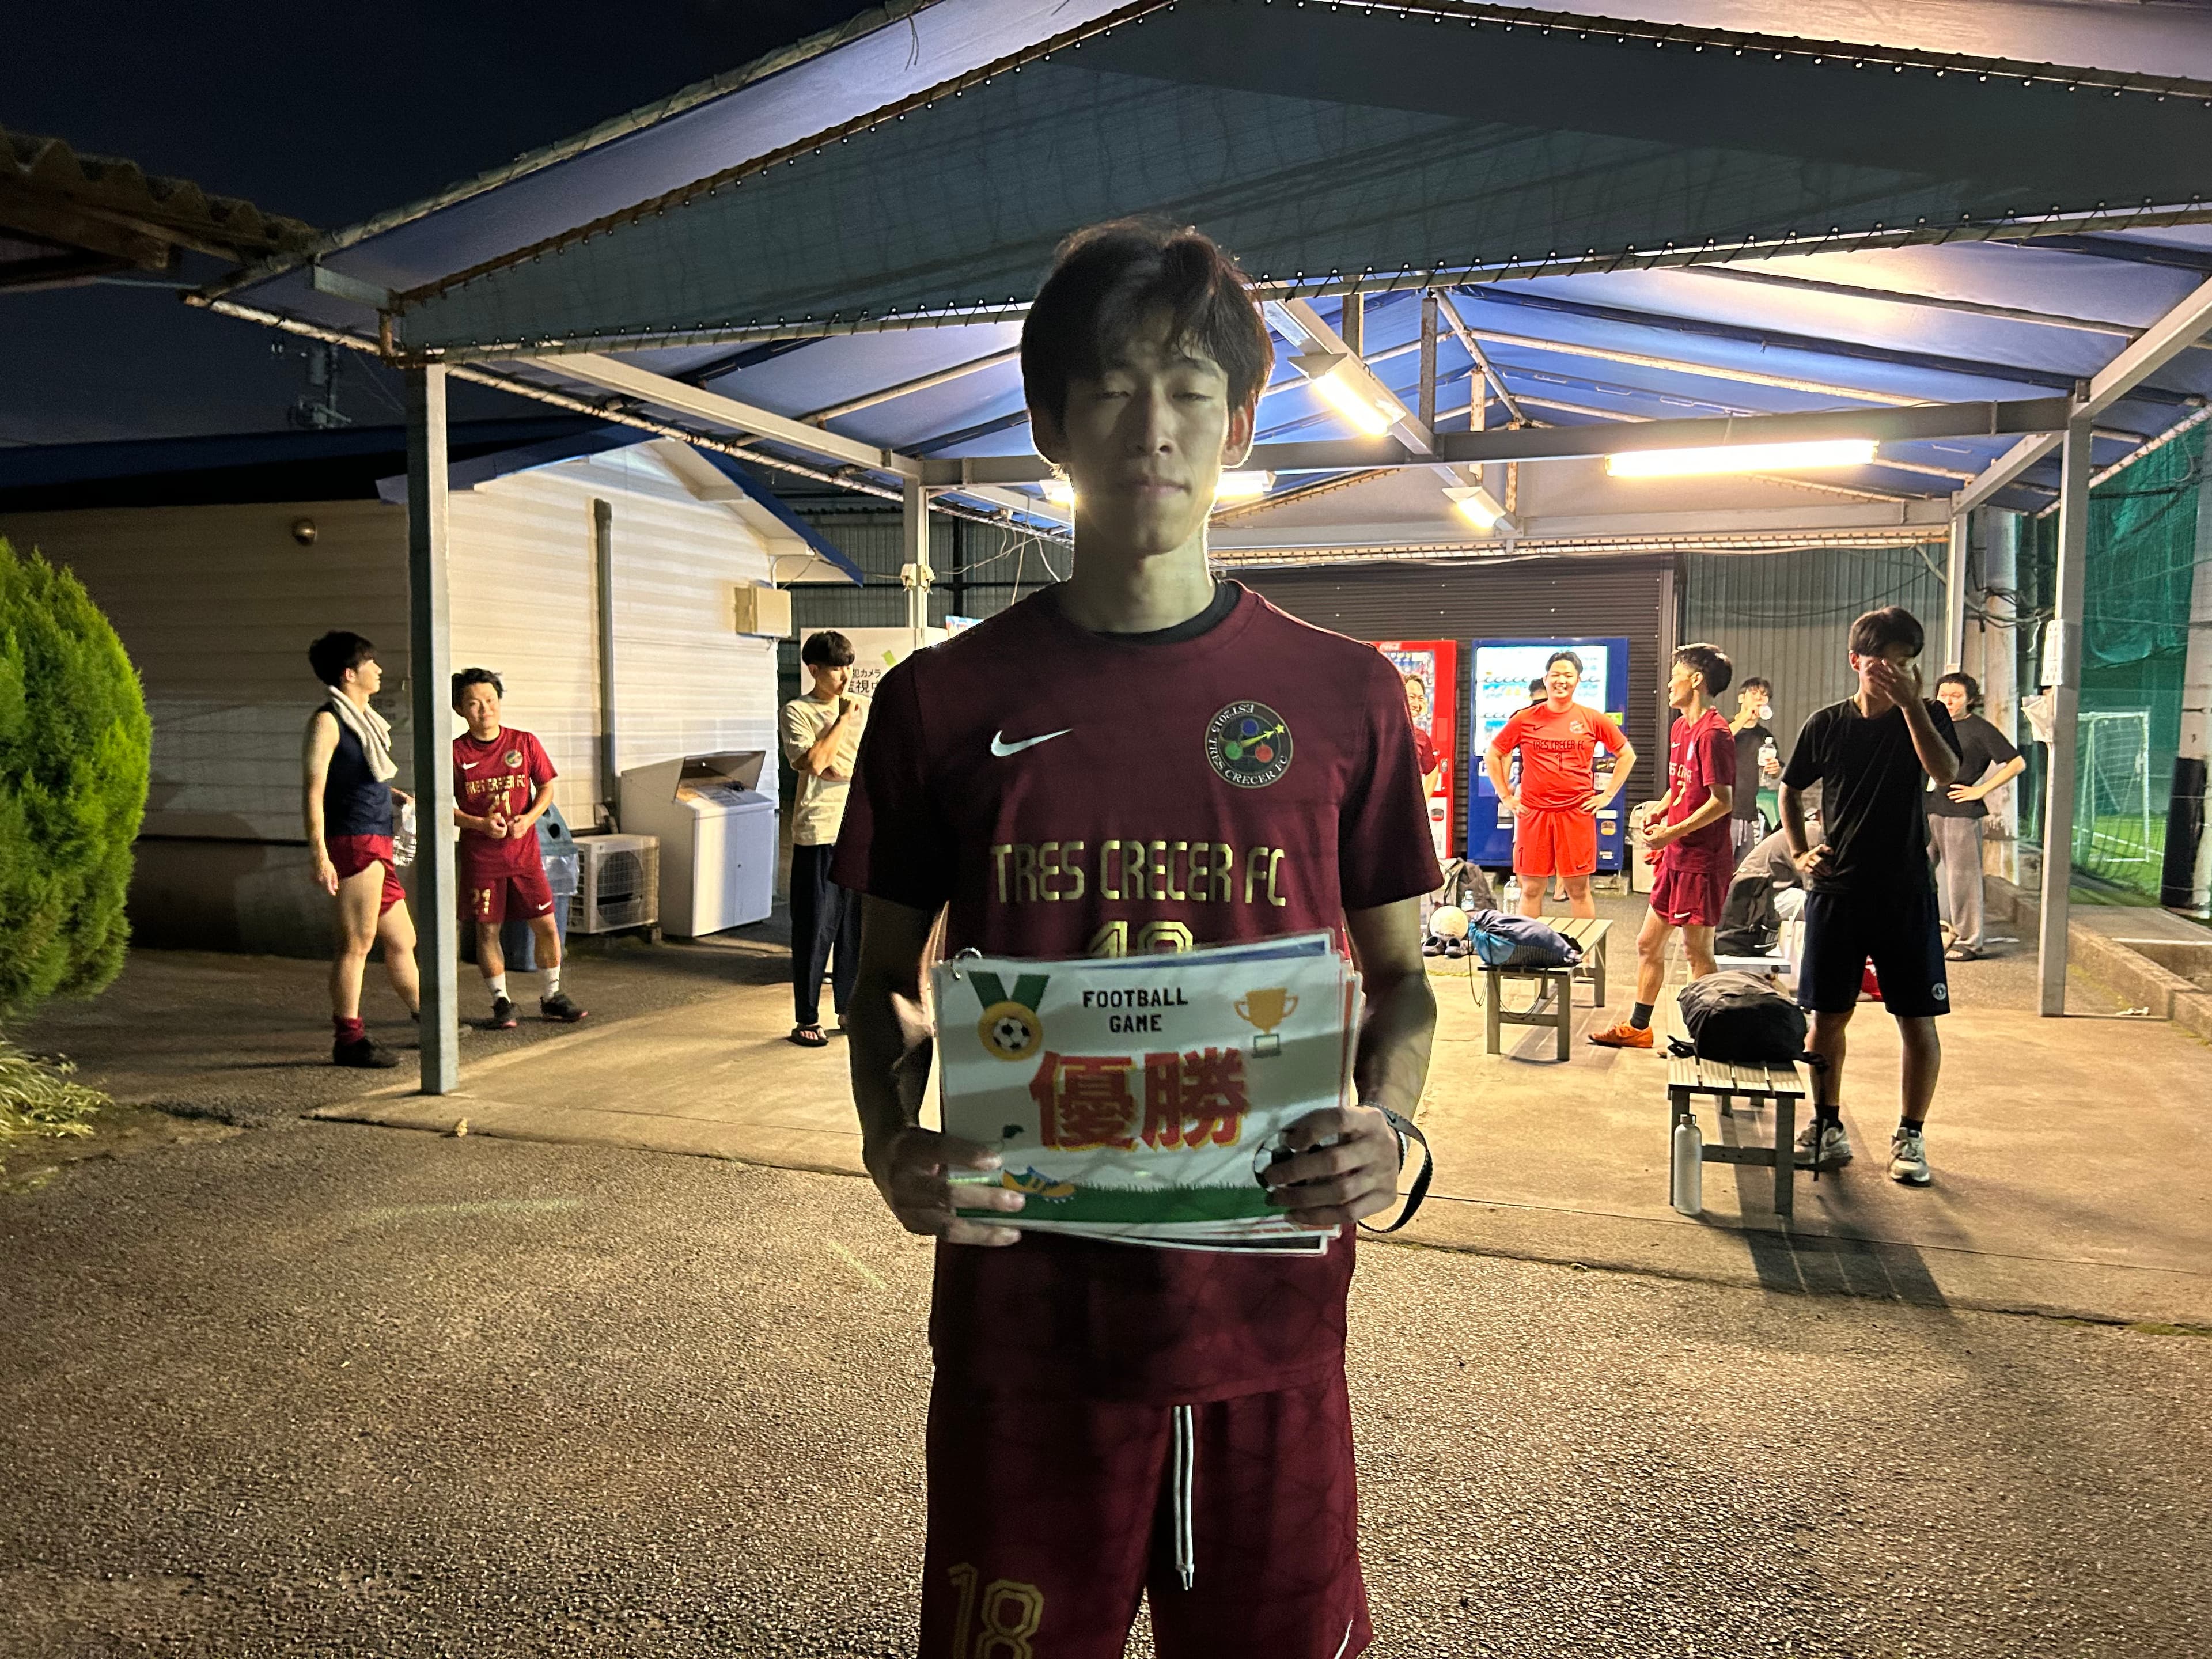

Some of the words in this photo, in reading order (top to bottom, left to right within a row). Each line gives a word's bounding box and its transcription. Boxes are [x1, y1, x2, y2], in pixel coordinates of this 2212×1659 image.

[1209, 737, 1225, 770] TRES
[1225, 770, 1276, 785] CRECER
[1275, 755, 1287, 771] FC
[1672, 781, 1686, 806] 7
[990, 841, 1084, 903] TRES
[1100, 840, 1233, 903] CRECER
[1244, 846, 1286, 907] FC
[1083, 987, 1188, 1008] FOOTBALL
[1109, 1014, 1162, 1033] GAME
[1029, 1046, 1251, 1152] 優勝
[948, 1562, 1044, 1659] 18
